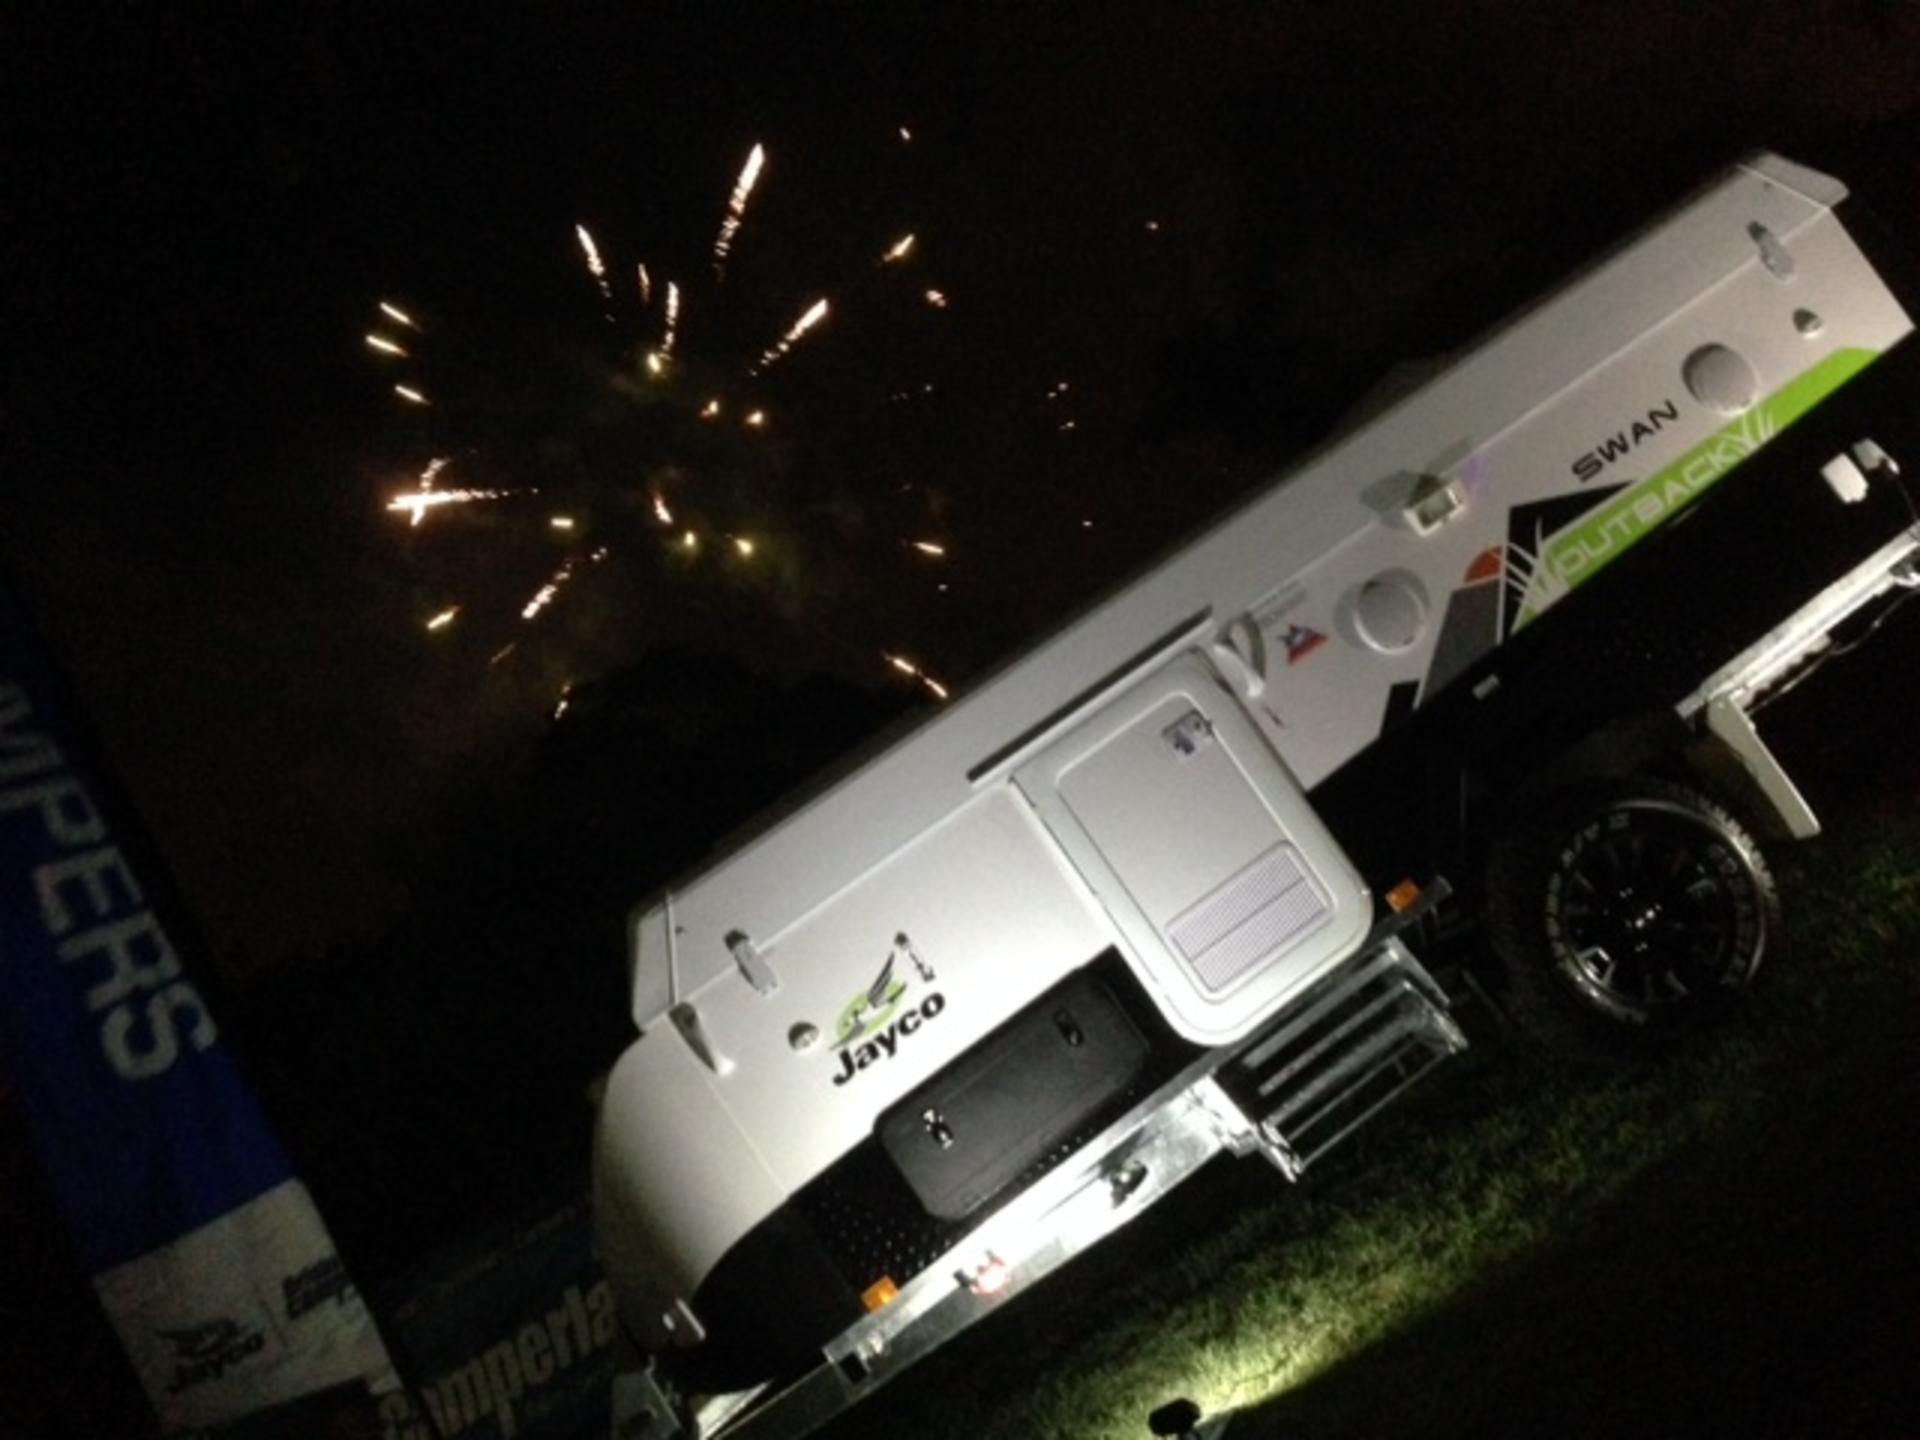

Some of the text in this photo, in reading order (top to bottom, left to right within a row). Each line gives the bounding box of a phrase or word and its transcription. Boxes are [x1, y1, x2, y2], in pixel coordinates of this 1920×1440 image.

[1571, 399, 1679, 483] SWAN
[1554, 438, 1744, 580] OUTBACK
[832, 992, 946, 1087] Jayco
